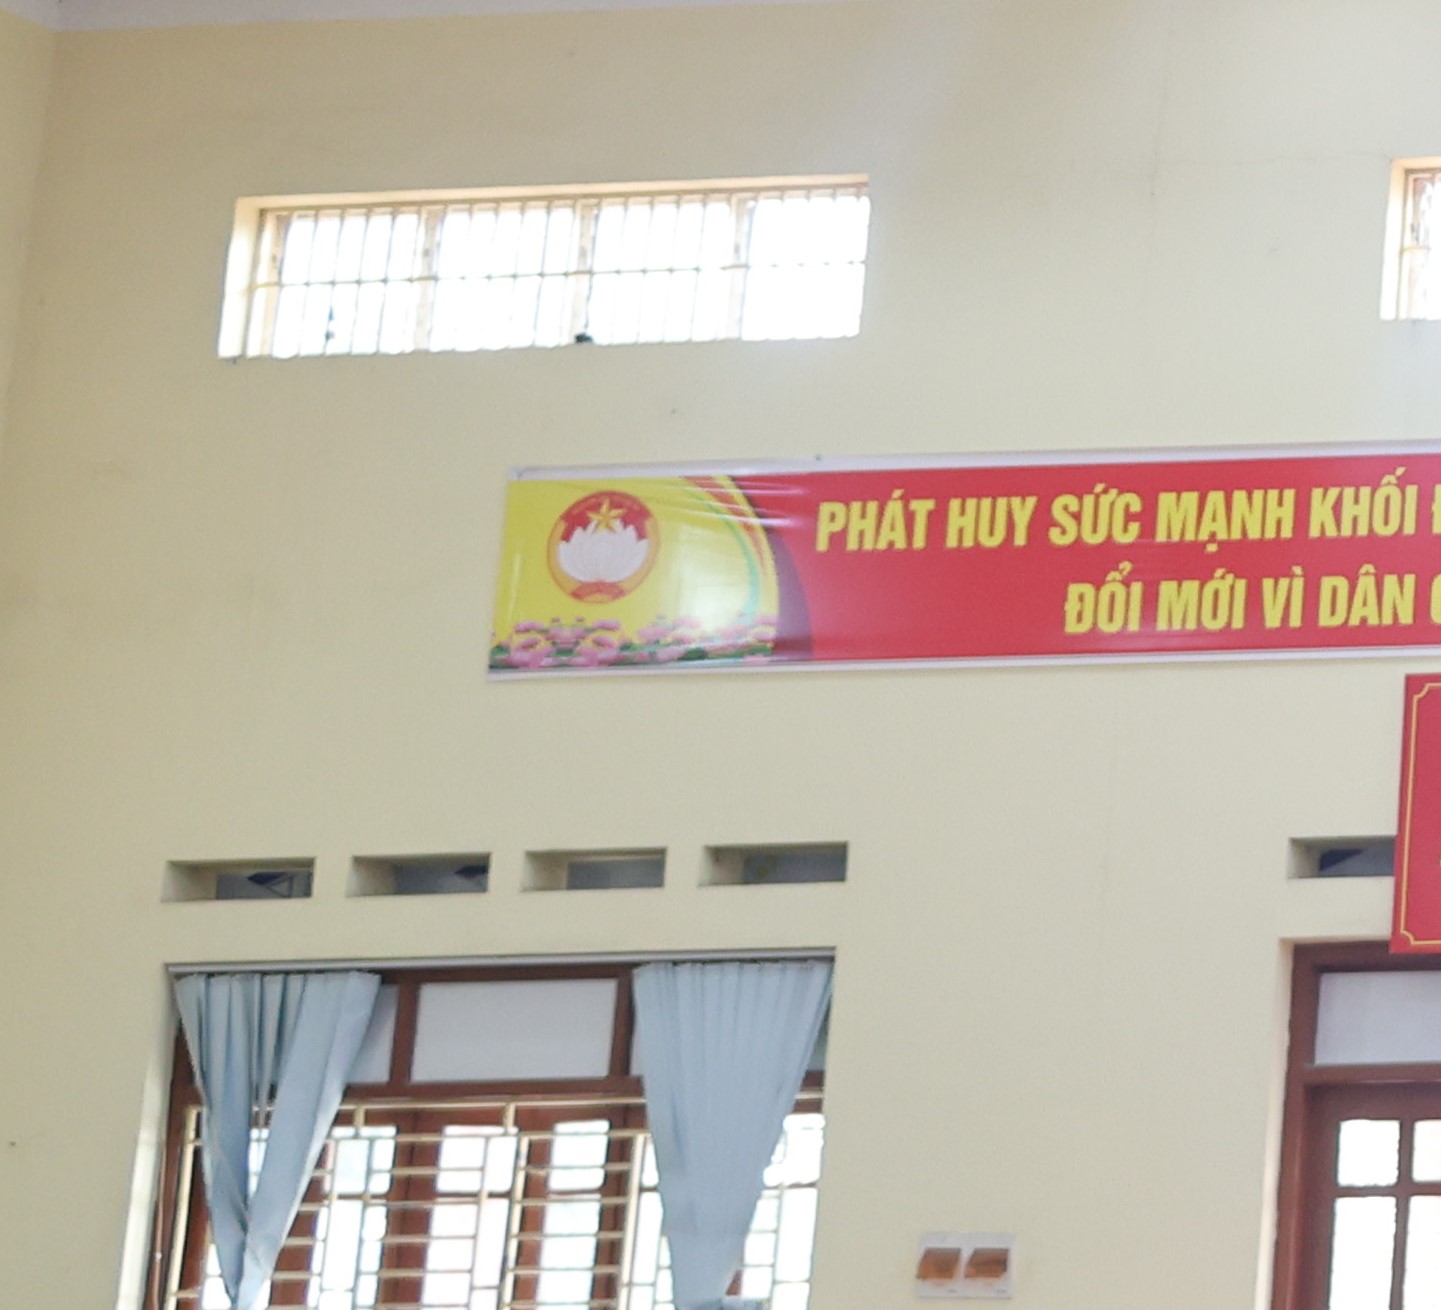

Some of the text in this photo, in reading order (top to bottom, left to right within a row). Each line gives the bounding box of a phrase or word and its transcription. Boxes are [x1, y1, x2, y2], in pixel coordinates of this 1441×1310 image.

[816, 489, 935, 552] PHÁT
[945, 495, 1036, 549] HUY
[1048, 483, 1142, 546] SỨC
[1155, 487, 1295, 553] MẠNH
[1309, 466, 1417, 539] KHỐI
[1064, 560, 1144, 635] ĐỔI
[1156, 574, 1246, 632] MỚI
[1261, 564, 1303, 628] VÌ
[1317, 564, 1416, 627] DÂN
